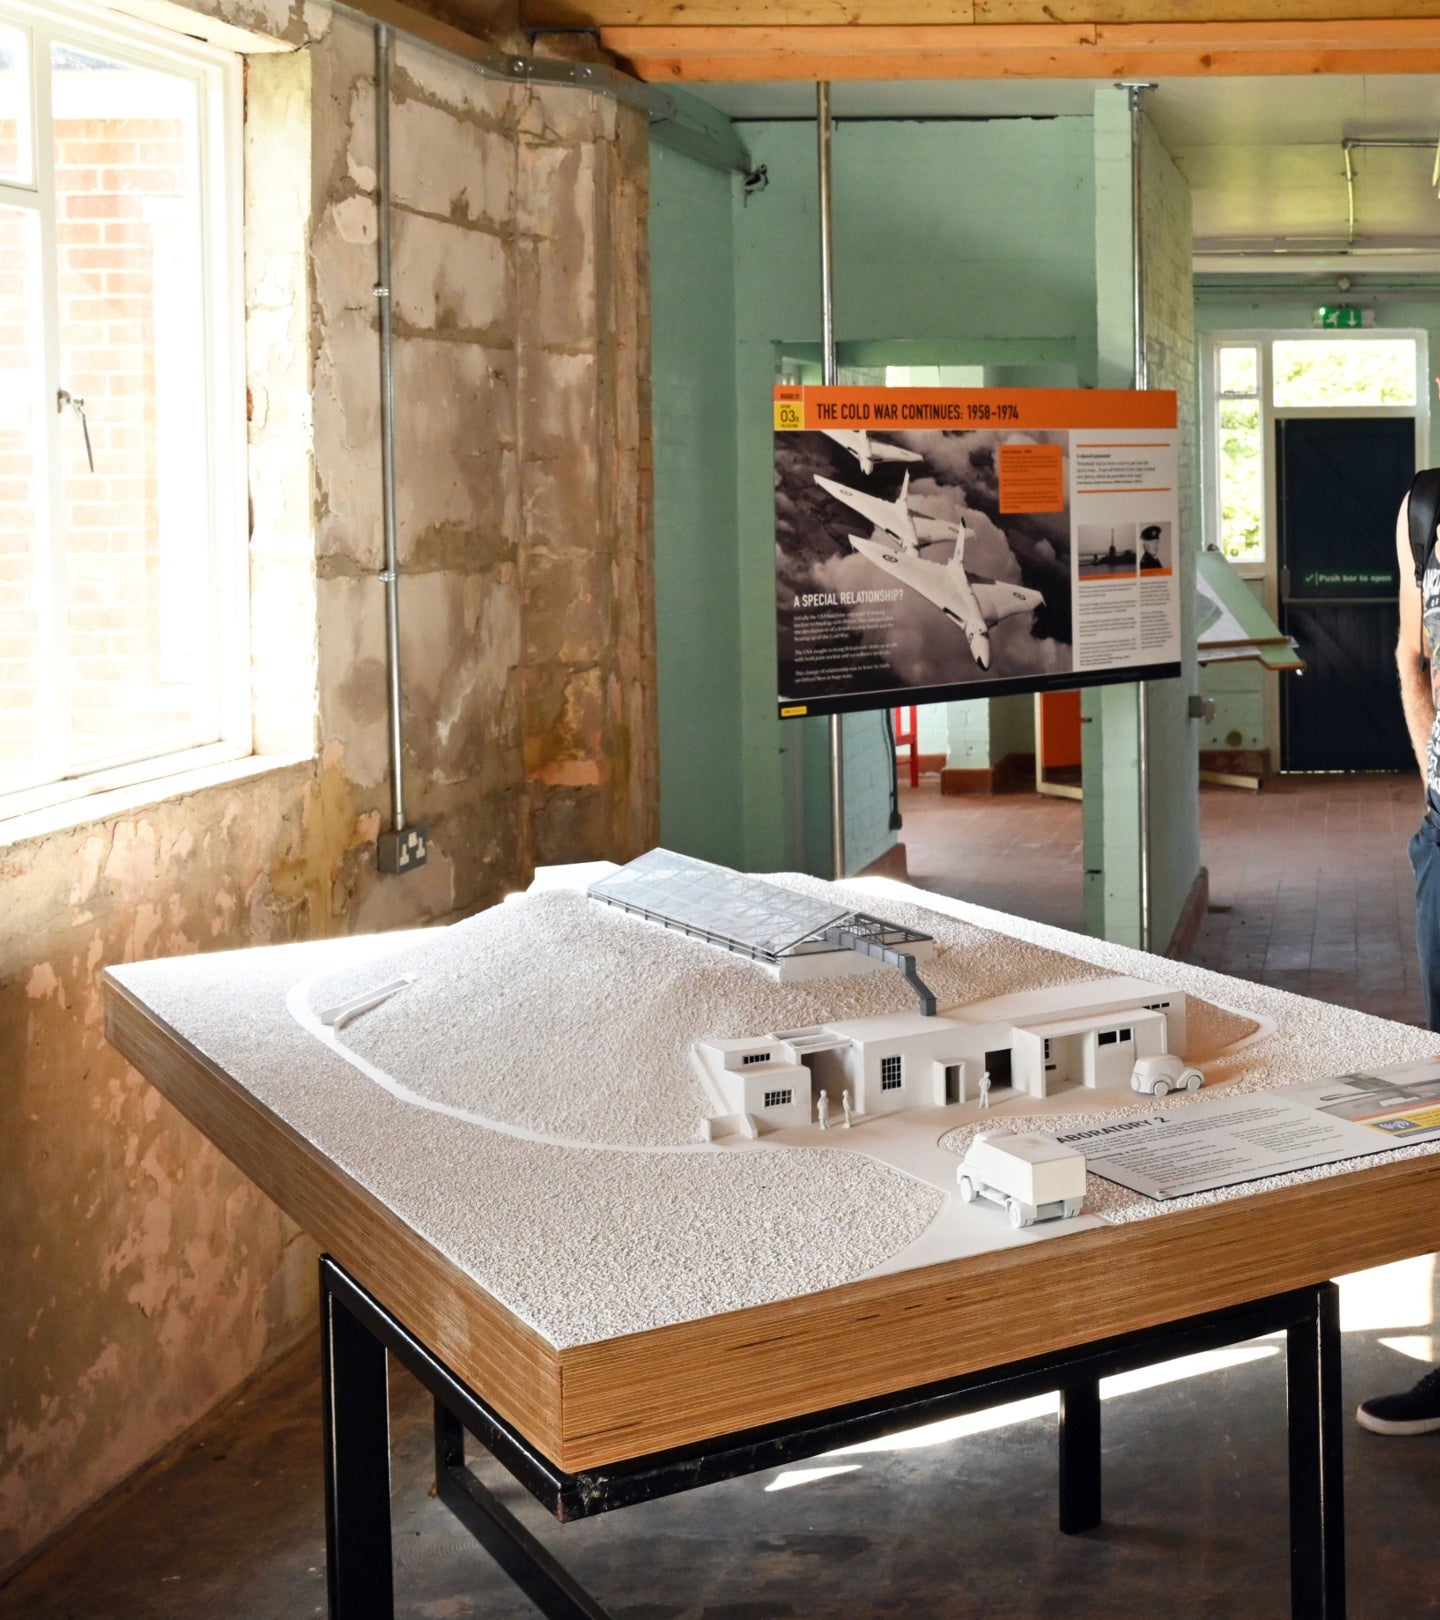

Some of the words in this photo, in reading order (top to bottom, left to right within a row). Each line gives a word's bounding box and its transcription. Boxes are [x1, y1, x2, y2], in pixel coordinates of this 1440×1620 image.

[816, 403, 838, 420] THE
[841, 404, 870, 420] COLD
[874, 404, 898, 420] WAR
[901, 404, 964, 420] CONTINUES:
[966, 405, 1019, 420] 1958-1974
[1319, 574, 1341, 582] Push
[1342, 574, 1358, 582] bar
[1370, 576, 1392, 584] open
[794, 595, 801, 608] A
[802, 593, 839, 607] SPECIAL
[840, 588, 904, 605] RELATIONSHIP?
[1056, 1119, 1152, 1144] ABORATORY
